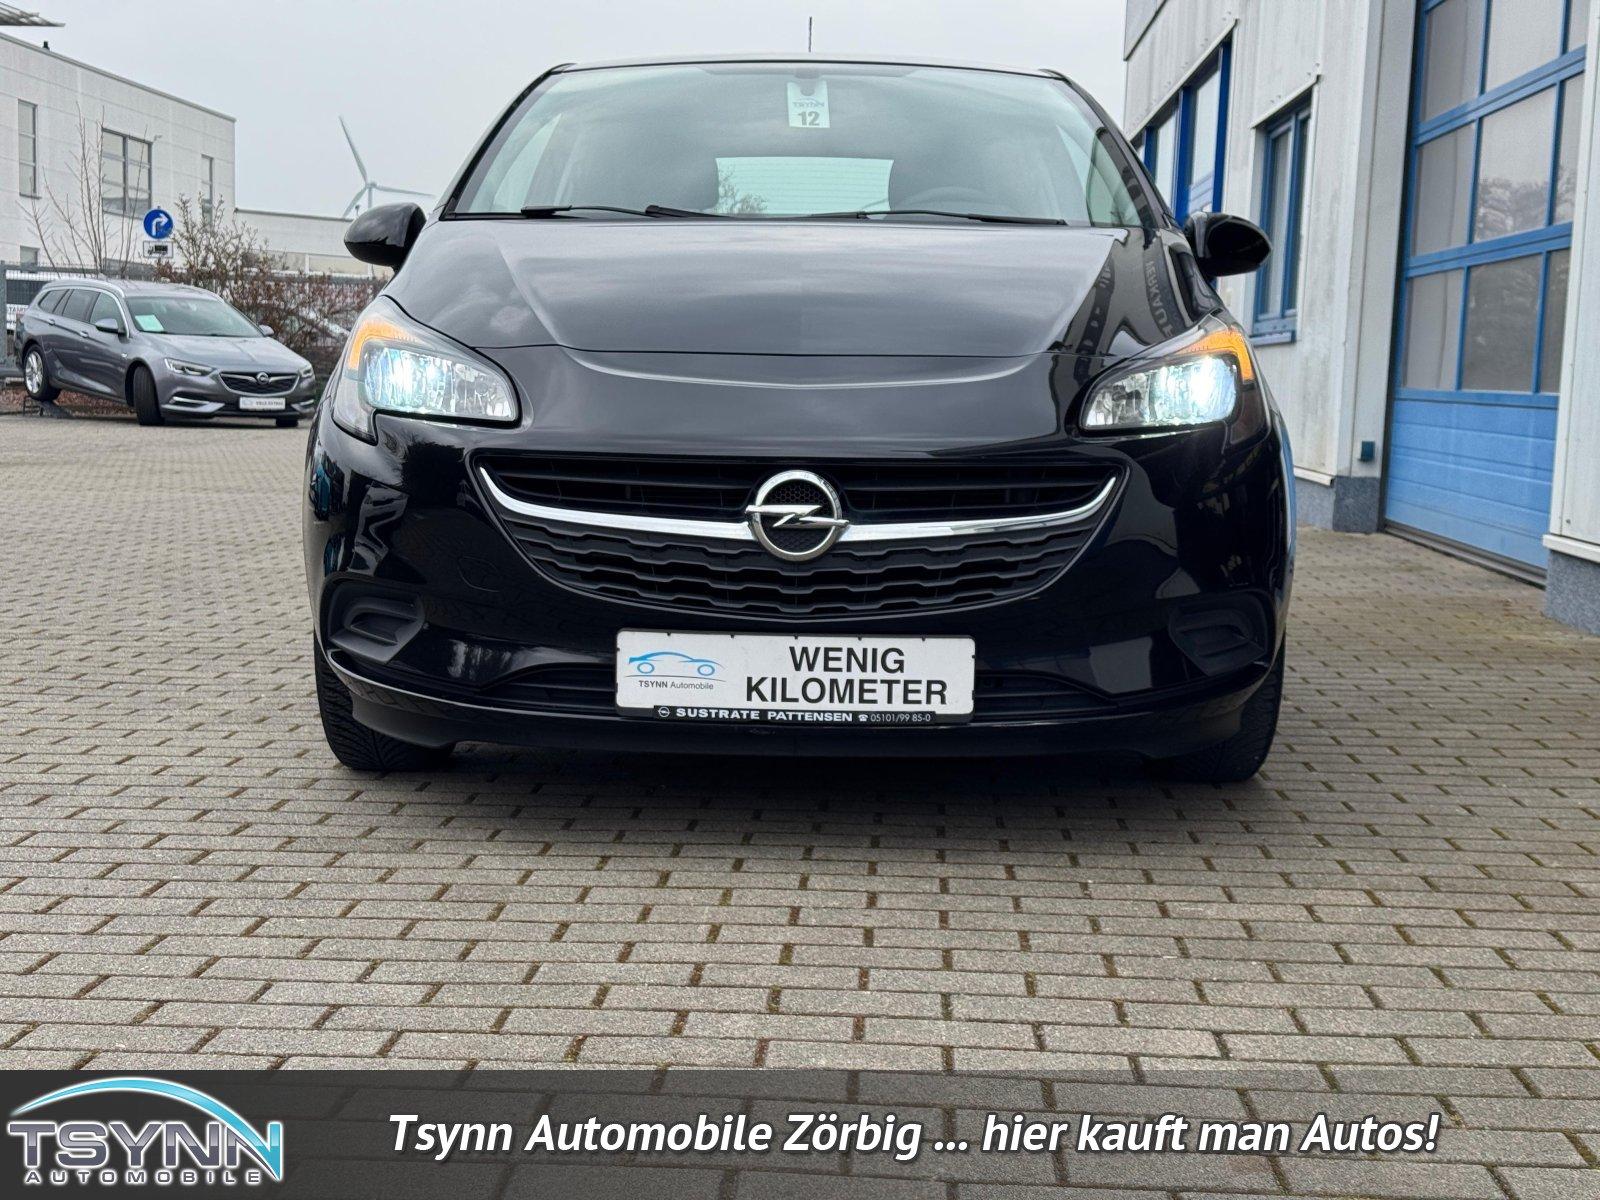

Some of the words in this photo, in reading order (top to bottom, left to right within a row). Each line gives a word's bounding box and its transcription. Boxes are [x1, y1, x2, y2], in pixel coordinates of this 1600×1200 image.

[797, 111, 820, 126] 12
[789, 646, 905, 674] WENIG
[638, 680, 669, 689] TSYNN
[670, 681, 714, 690] Automobile
[746, 677, 948, 705] KILOMETER
[676, 707, 760, 720] SUSTRATE
[767, 710, 853, 723] PATTENSEN
